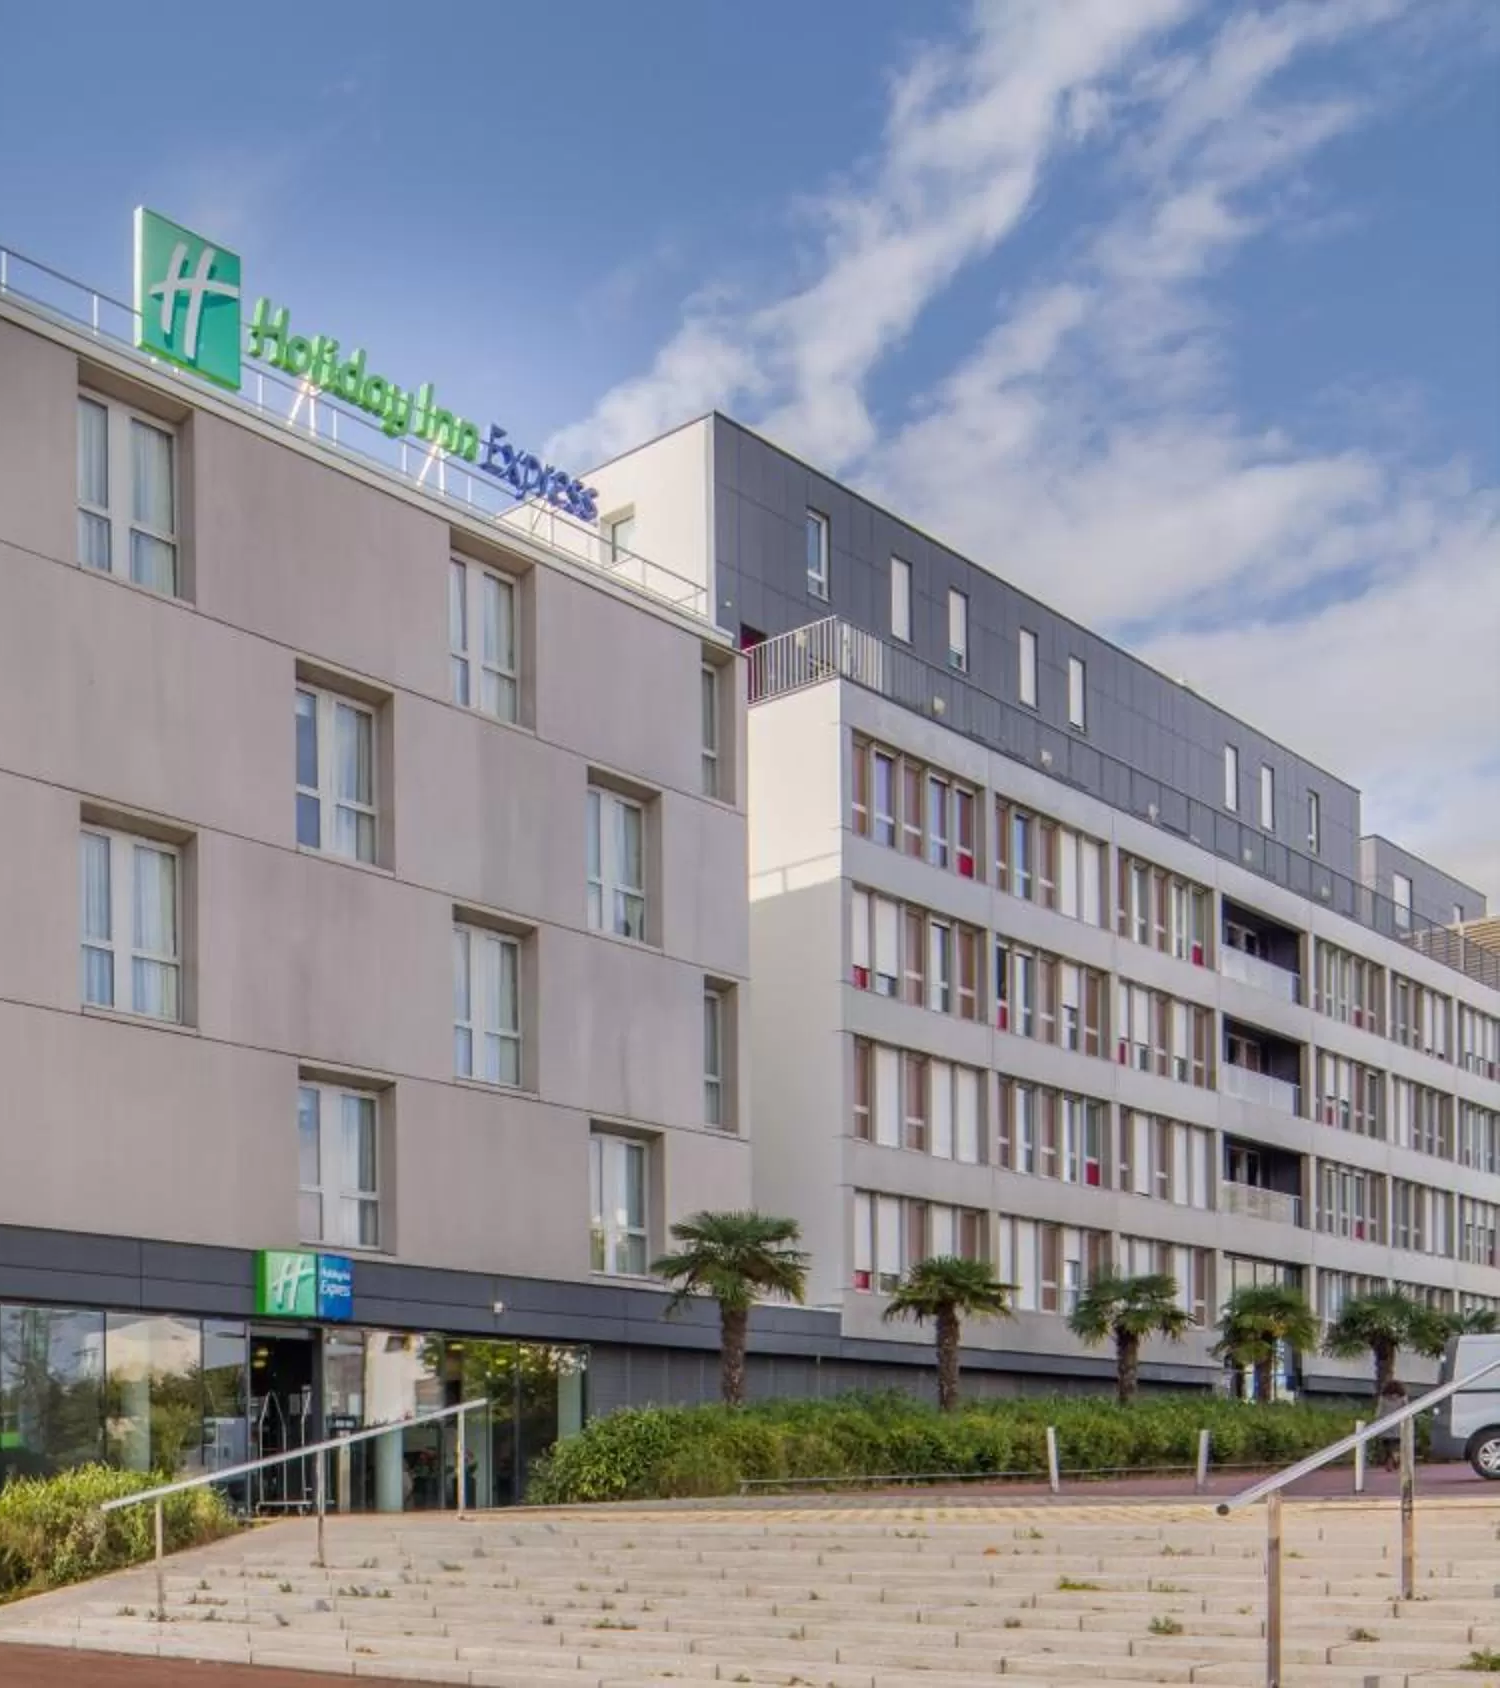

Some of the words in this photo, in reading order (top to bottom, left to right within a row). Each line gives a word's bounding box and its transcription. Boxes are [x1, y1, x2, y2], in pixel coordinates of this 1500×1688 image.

[248, 298, 414, 438] Holiday
[411, 382, 481, 462] Inn
[480, 423, 600, 525] Express
